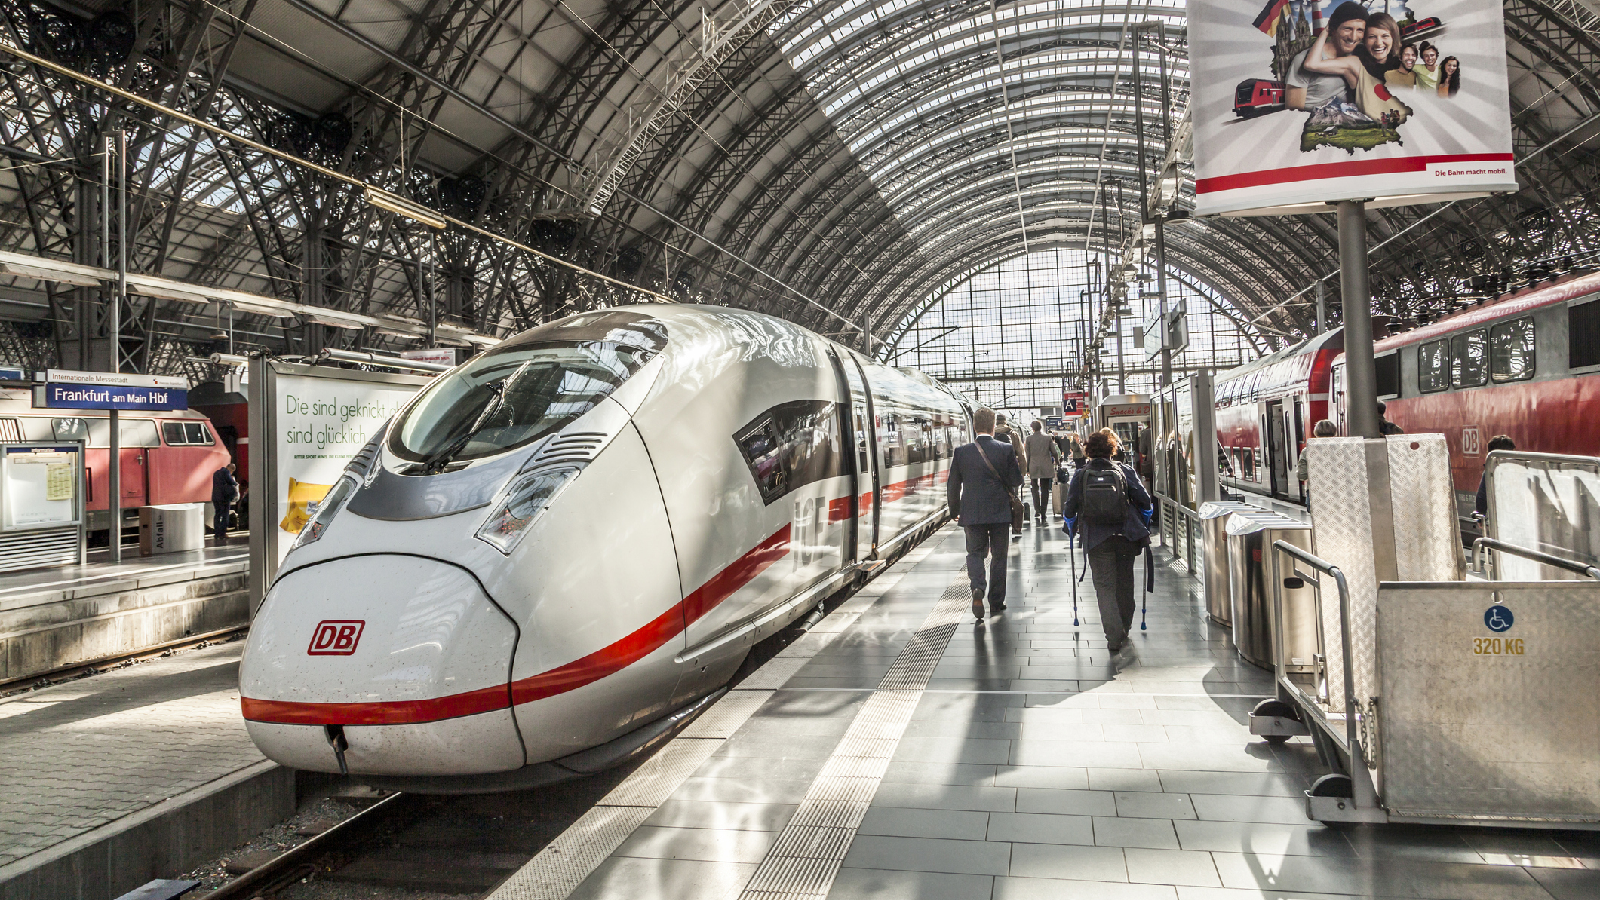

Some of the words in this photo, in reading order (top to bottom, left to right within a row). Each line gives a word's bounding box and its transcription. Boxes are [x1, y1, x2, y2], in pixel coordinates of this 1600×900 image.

[52, 373, 95, 382] Internationale
[95, 375, 128, 384] Messestadt
[54, 387, 110, 403] Frankfurt
[112, 395, 125, 403] am
[126, 393, 147, 404] Main
[148, 391, 169, 404] Hbf
[1065, 400, 1074, 410] A
[286, 394, 309, 416] Die
[312, 396, 337, 416] sind
[340, 398, 387, 423] geknickt,
[1110, 407, 1134, 415] Snacks
[286, 423, 313, 444] sind
[316, 423, 366, 450] glücklich
[1463, 430, 1479, 453] DB
[156, 522, 164, 549] Abfall
[312, 624, 358, 651] DB
[1473, 638, 1501, 655] 320
[1505, 638, 1524, 655] KG
